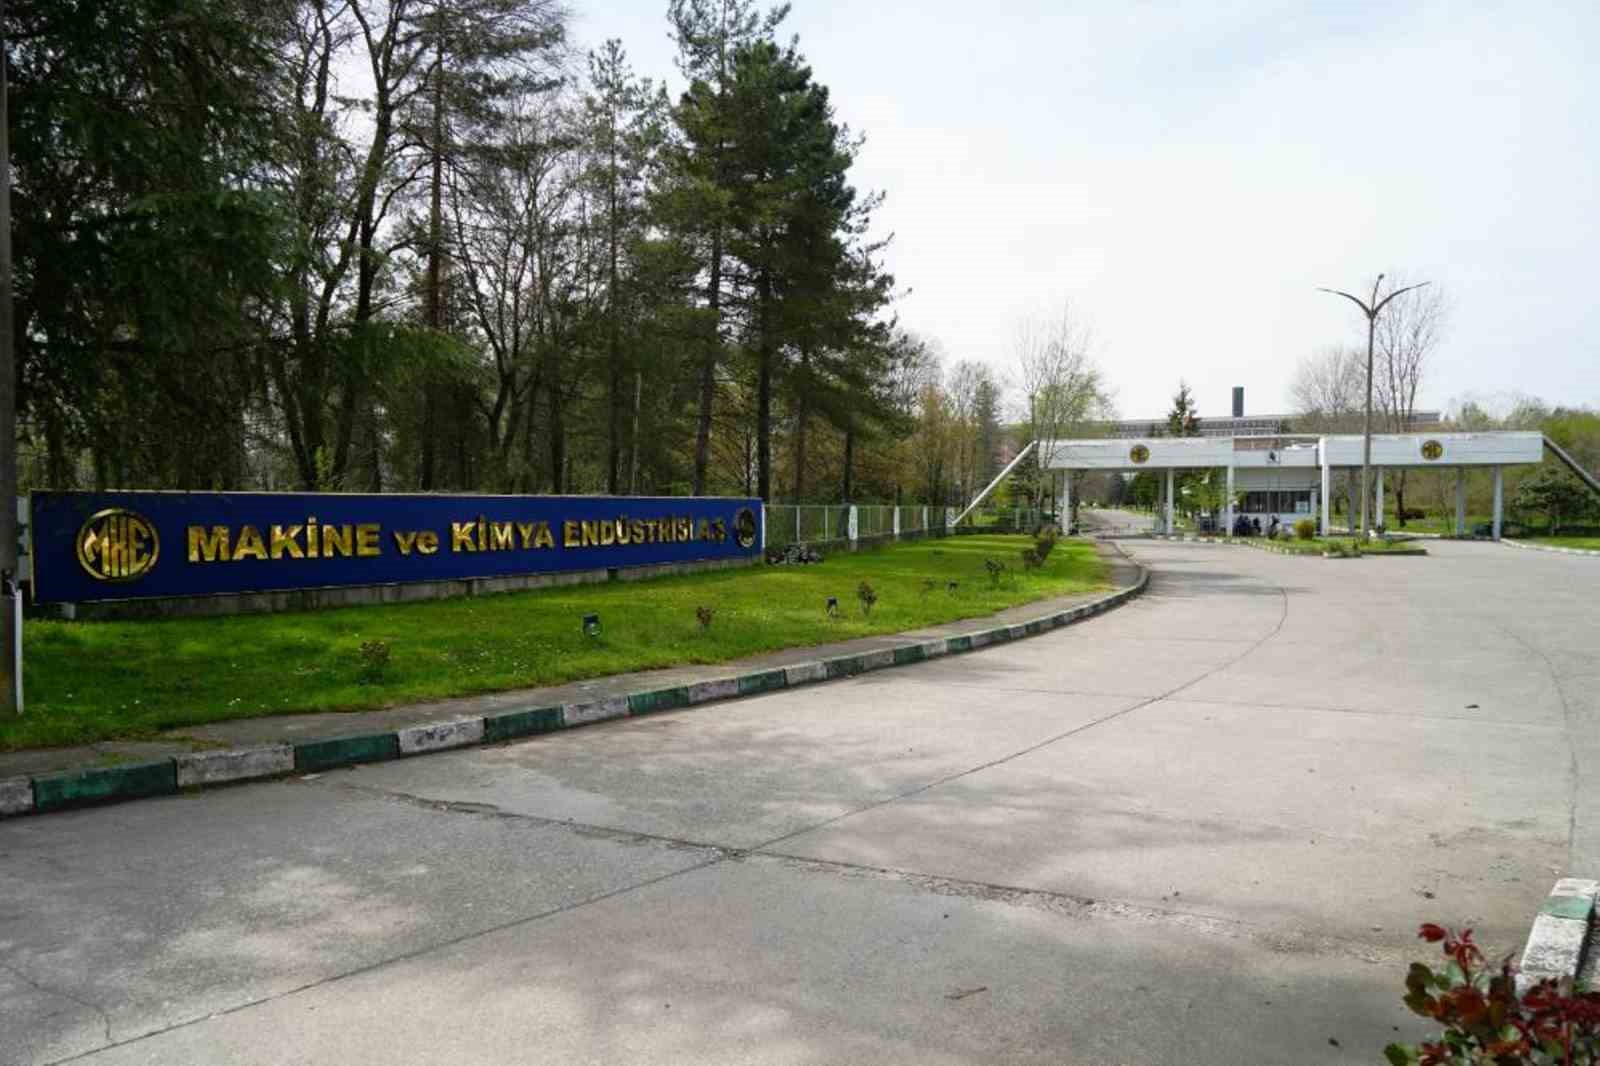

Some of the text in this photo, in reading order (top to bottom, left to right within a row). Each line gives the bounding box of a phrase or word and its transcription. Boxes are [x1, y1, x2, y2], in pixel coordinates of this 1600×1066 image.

[187, 516, 382, 562] MAKİNE
[393, 529, 440, 555] ve
[452, 514, 554, 552] KİMYA
